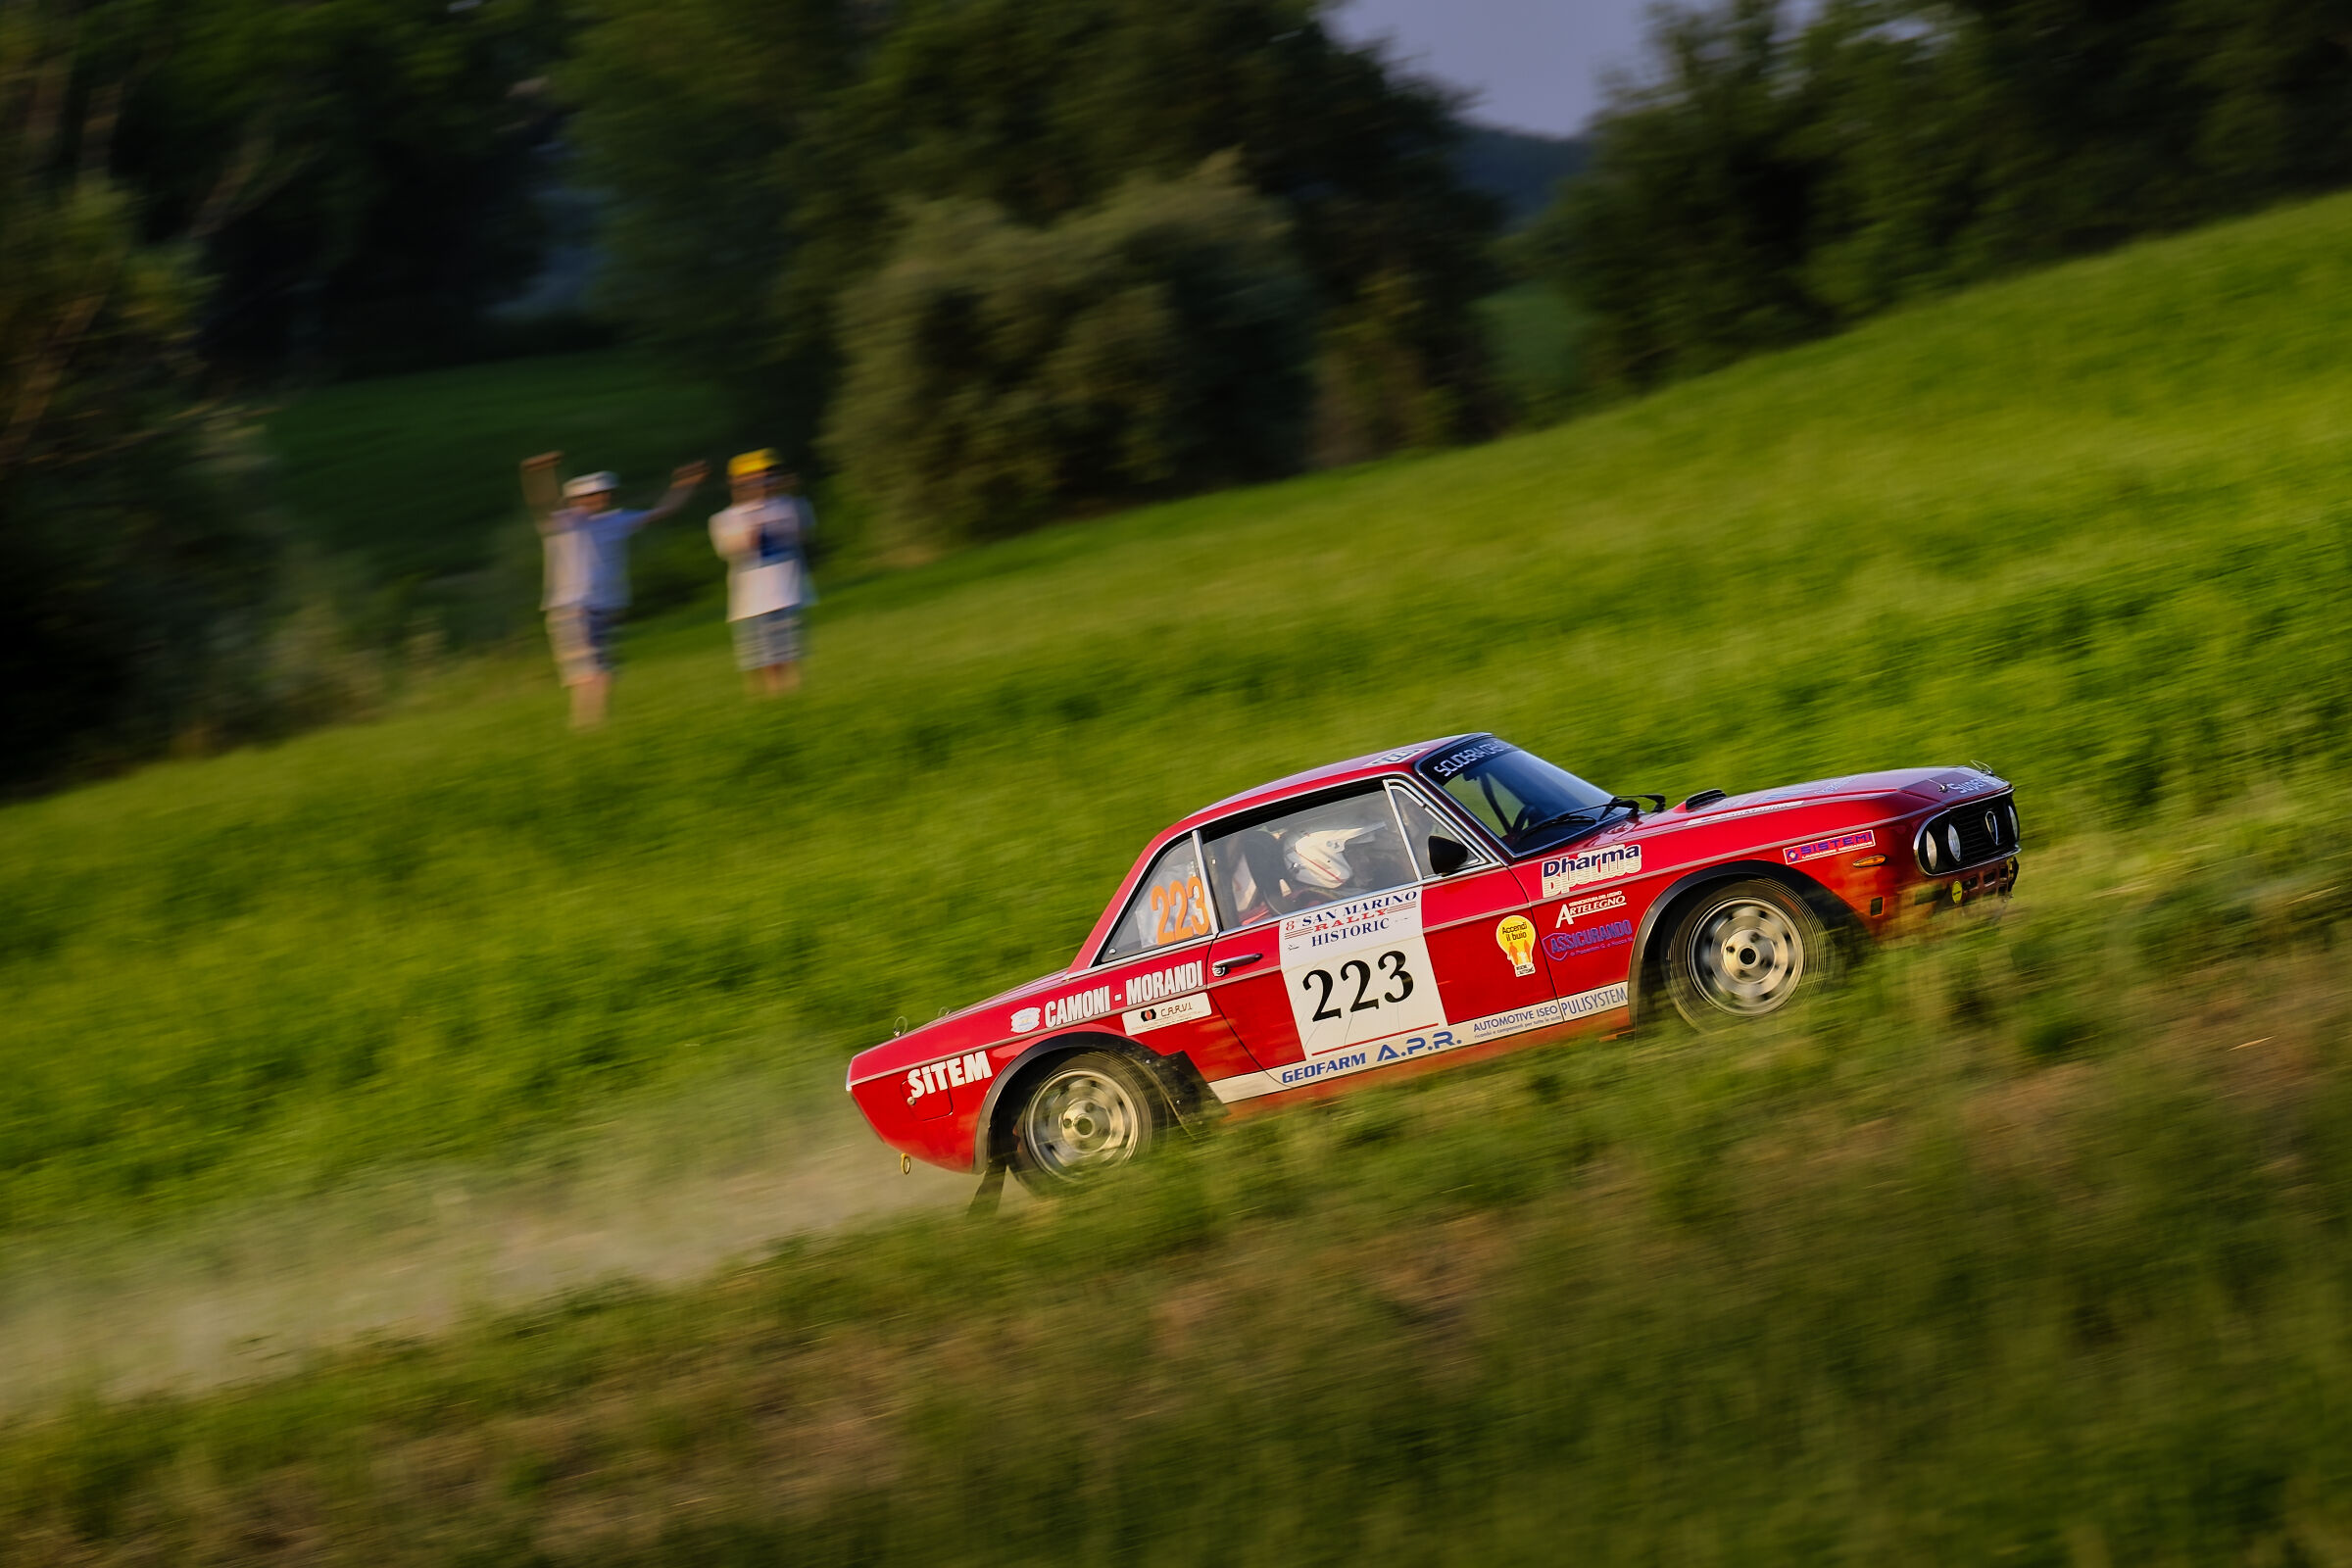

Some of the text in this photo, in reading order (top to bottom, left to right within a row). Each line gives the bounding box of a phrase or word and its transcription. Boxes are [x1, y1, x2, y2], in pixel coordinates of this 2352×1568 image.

[1800, 832, 1872, 855] SISTEMI
[1543, 845, 1641, 878] Dharma
[1151, 876, 1210, 946] 223
[1301, 909, 1338, 927] SAN
[1344, 891, 1417, 916] MARINO
[1314, 908, 1389, 932] RALLY
[1555, 896, 1626, 928] ARTELEGNO
[1311, 918, 1390, 947] HISTORIC
[1502, 921, 1528, 934] Accendi
[1512, 931, 1527, 941] buio
[1550, 919, 1633, 953] ASSICURANDO
[1045, 985, 1111, 1028] CAMONI
[1125, 960, 1203, 1005] MORANDI
[1302, 950, 1414, 1022] 223
[1561, 987, 1628, 1016] PULISYSTEM
[1473, 1005, 1558, 1032] AUTOMOTIVE ISEO
[1377, 1031, 1462, 1061] A.P.R.
[1282, 1052, 1366, 1084] GEOFARM
